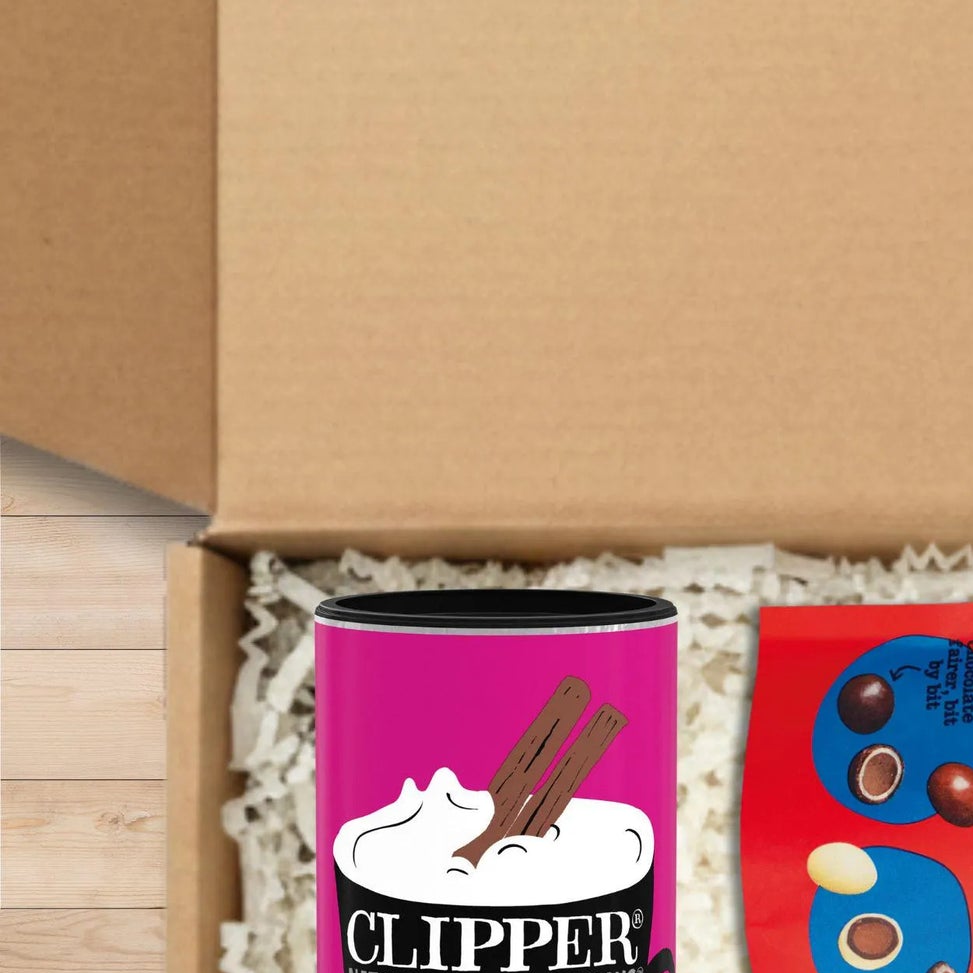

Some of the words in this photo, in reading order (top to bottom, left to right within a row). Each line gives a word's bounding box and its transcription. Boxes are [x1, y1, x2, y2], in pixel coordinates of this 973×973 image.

[924, 659, 944, 680] by
[926, 683, 942, 711] bit
[944, 698, 960, 726] bit
